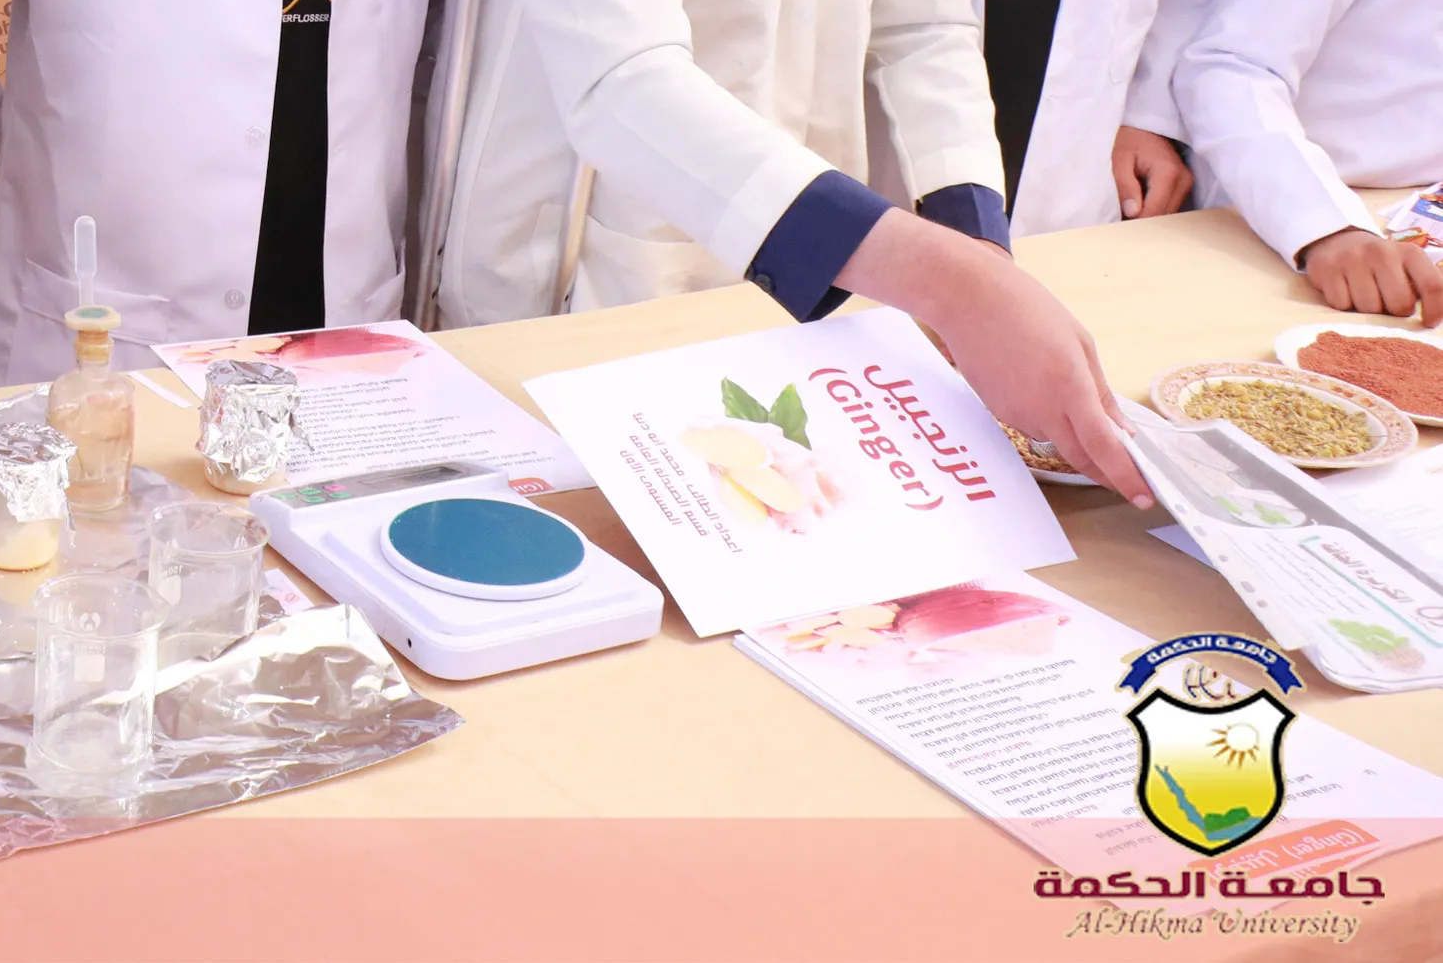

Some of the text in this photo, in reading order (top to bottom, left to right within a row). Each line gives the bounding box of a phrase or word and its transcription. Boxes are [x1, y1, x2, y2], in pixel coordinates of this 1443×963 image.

[282, 14, 330, 23] ERFLOSSER
[808, 368, 944, 510] (Ginger)
[863, 365, 996, 501] الزنجبيل
